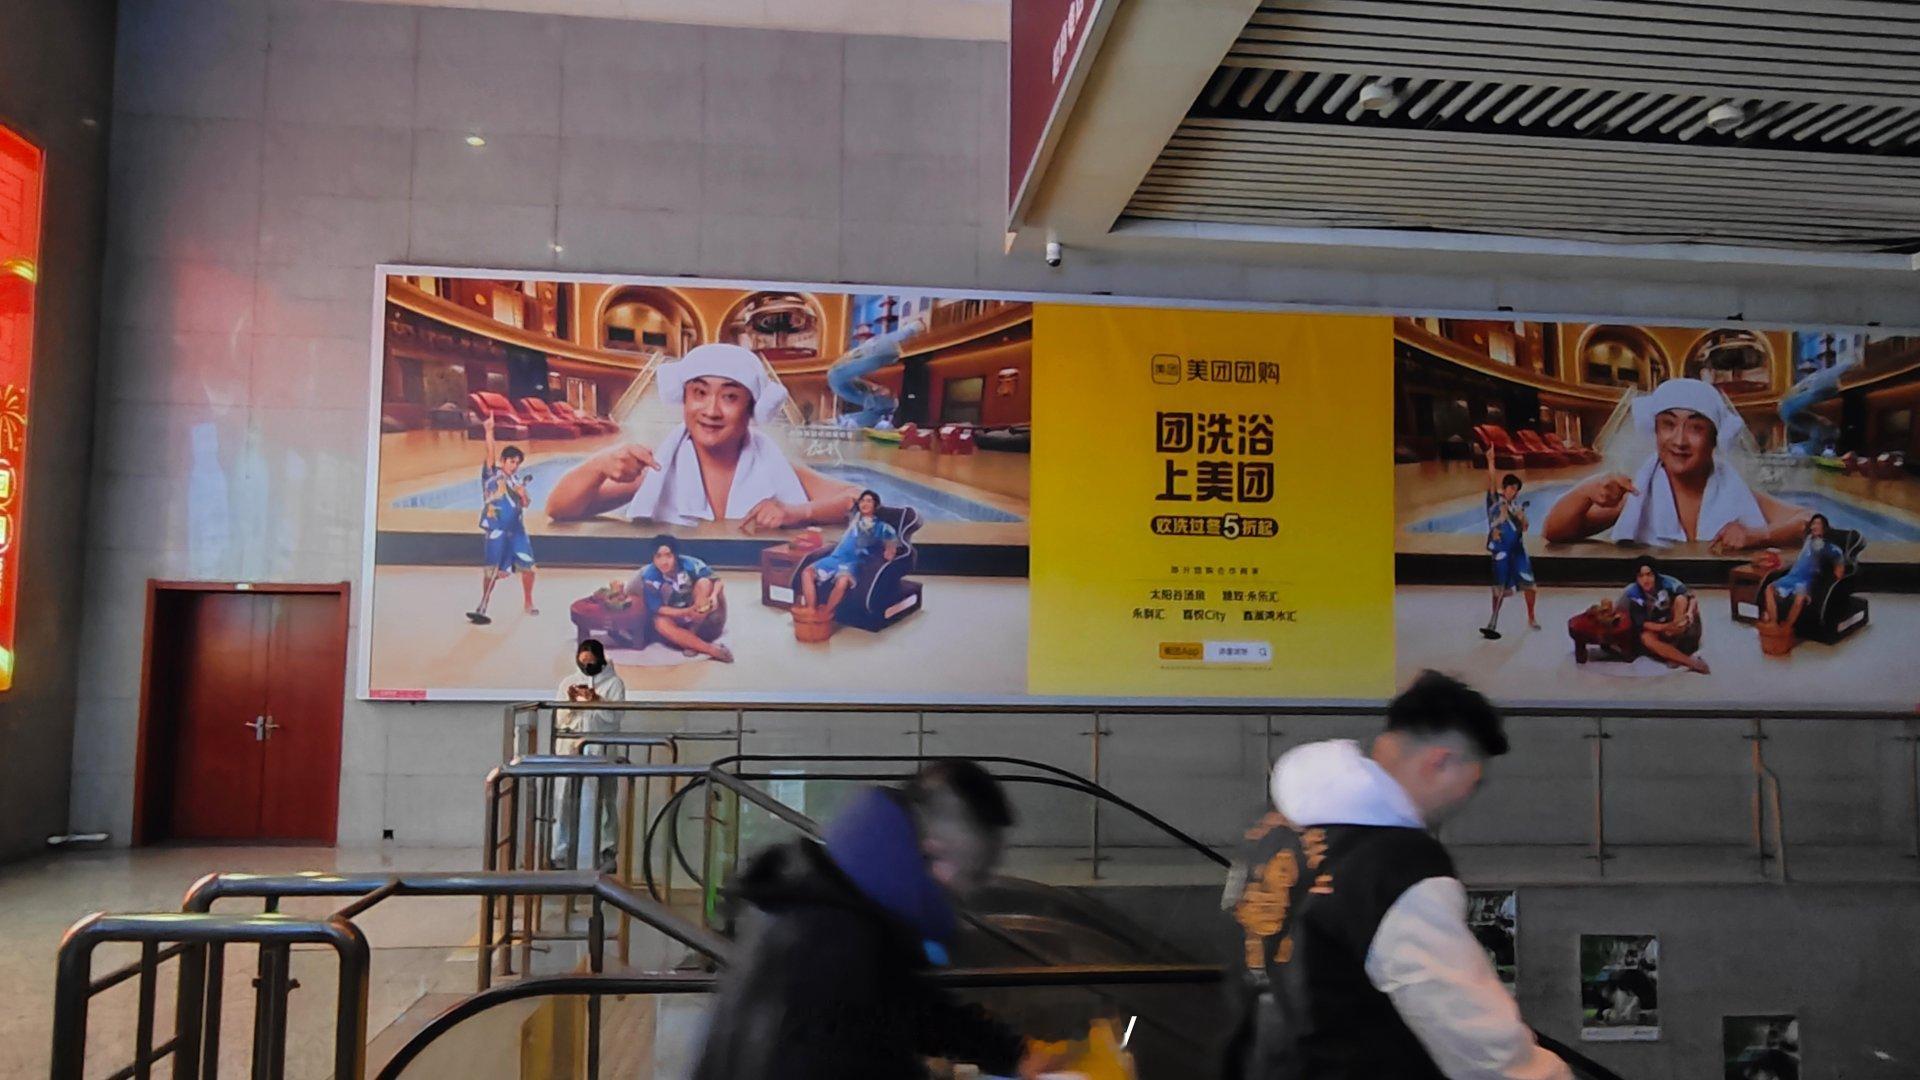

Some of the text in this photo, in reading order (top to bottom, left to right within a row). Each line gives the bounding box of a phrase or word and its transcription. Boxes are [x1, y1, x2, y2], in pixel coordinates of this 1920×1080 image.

[1187, 359, 1280, 384] 美团团购
[1156, 411, 1273, 455] 团洗浴
[1155, 459, 1274, 503] 上美团
